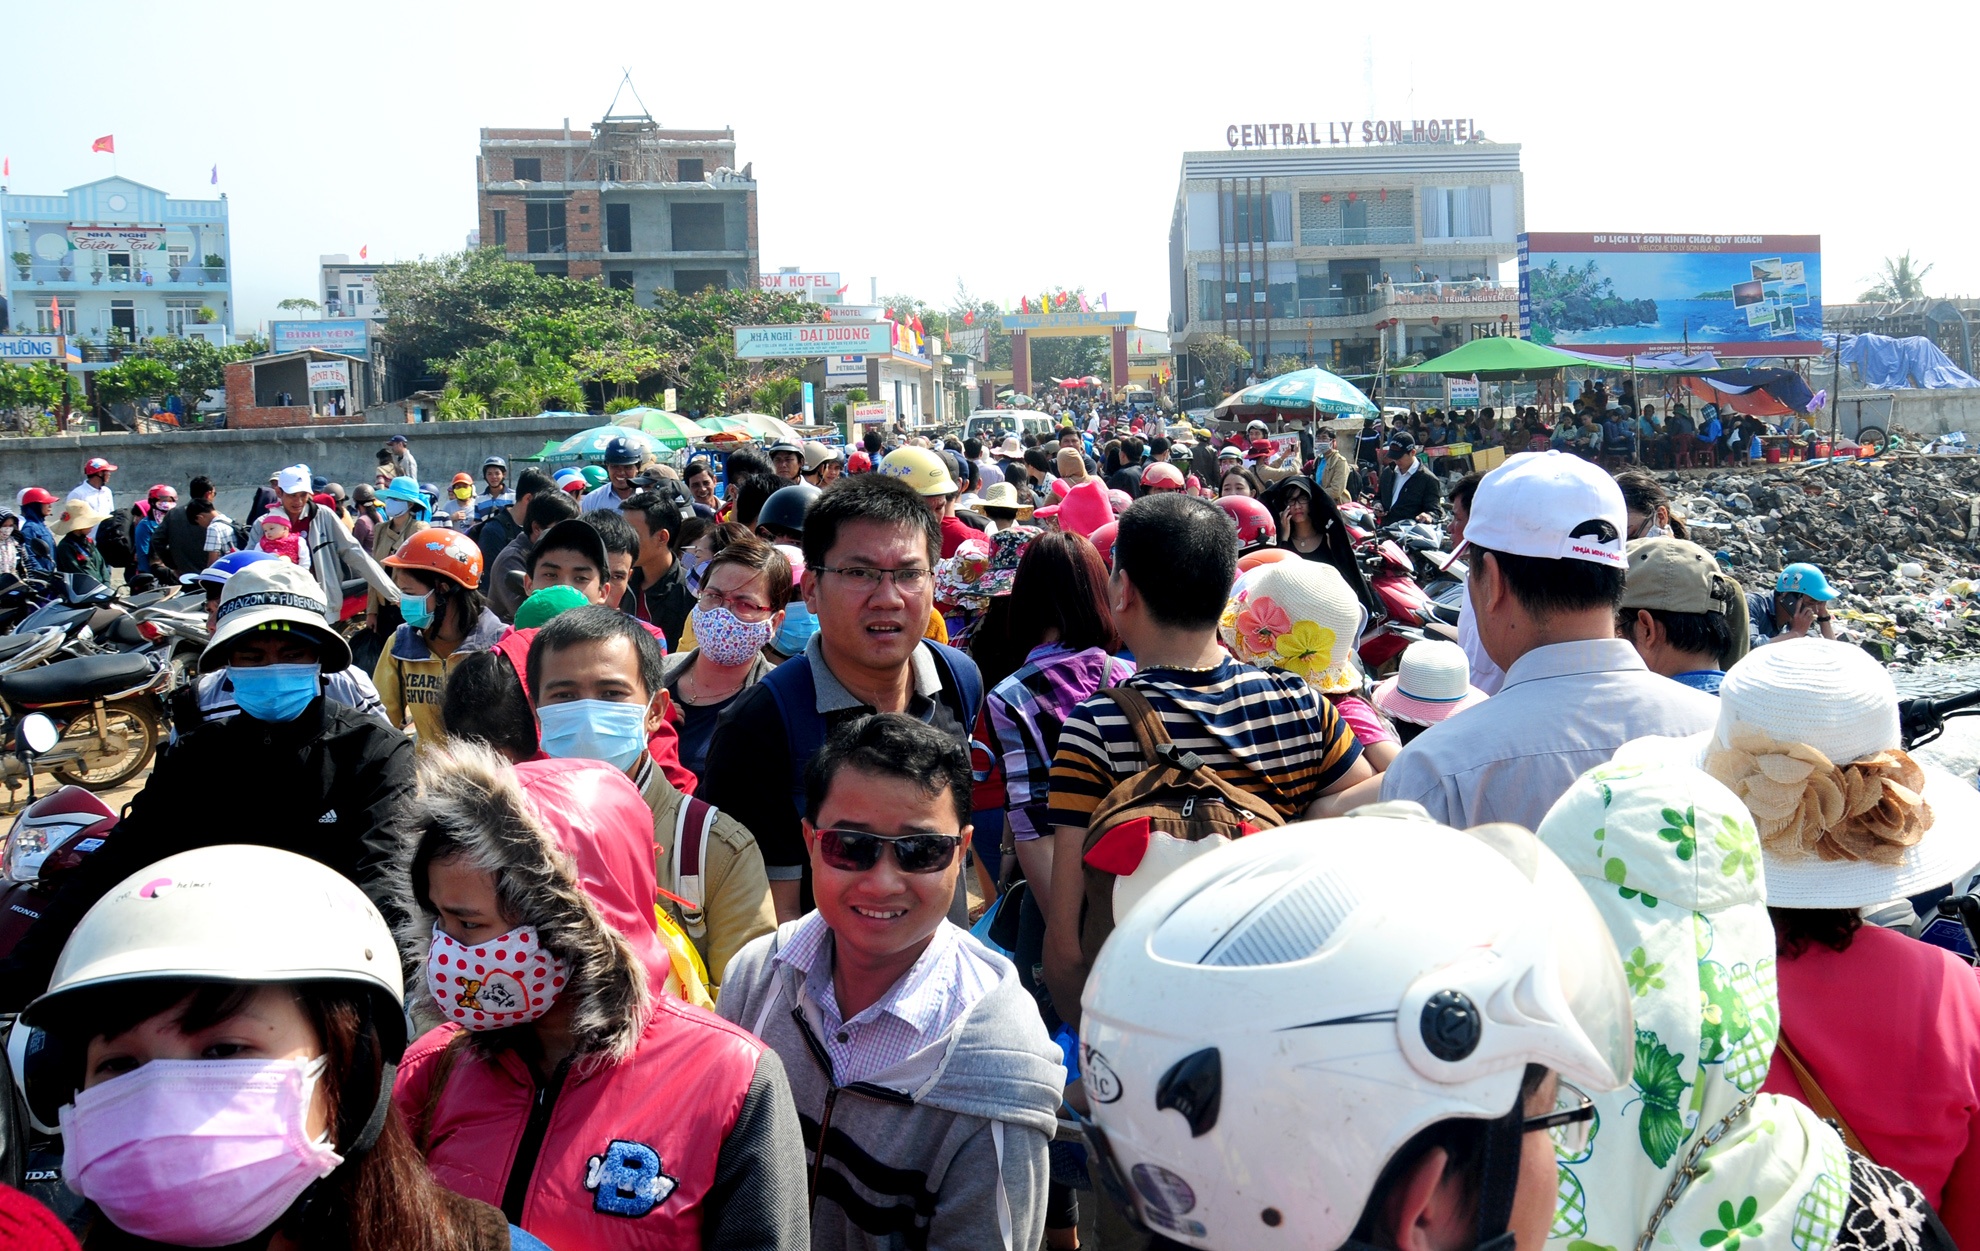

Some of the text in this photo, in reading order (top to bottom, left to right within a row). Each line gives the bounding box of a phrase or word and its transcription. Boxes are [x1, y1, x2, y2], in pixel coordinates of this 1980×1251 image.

[1227, 118, 1480, 147] CENTRAL LY SON HOTEL
[1593, 235, 1607, 244] DU
[1609, 235, 1629, 245] LỊCH
[1664, 234, 1686, 244] KÍNH
[1638, 244, 1669, 252] WELCOME
[1670, 244, 1678, 252] TO
[1700, 244, 1721, 252] ISLAND
[1444, 295, 1471, 303] TRUNG
[840, 308, 862, 316] HOTEL
